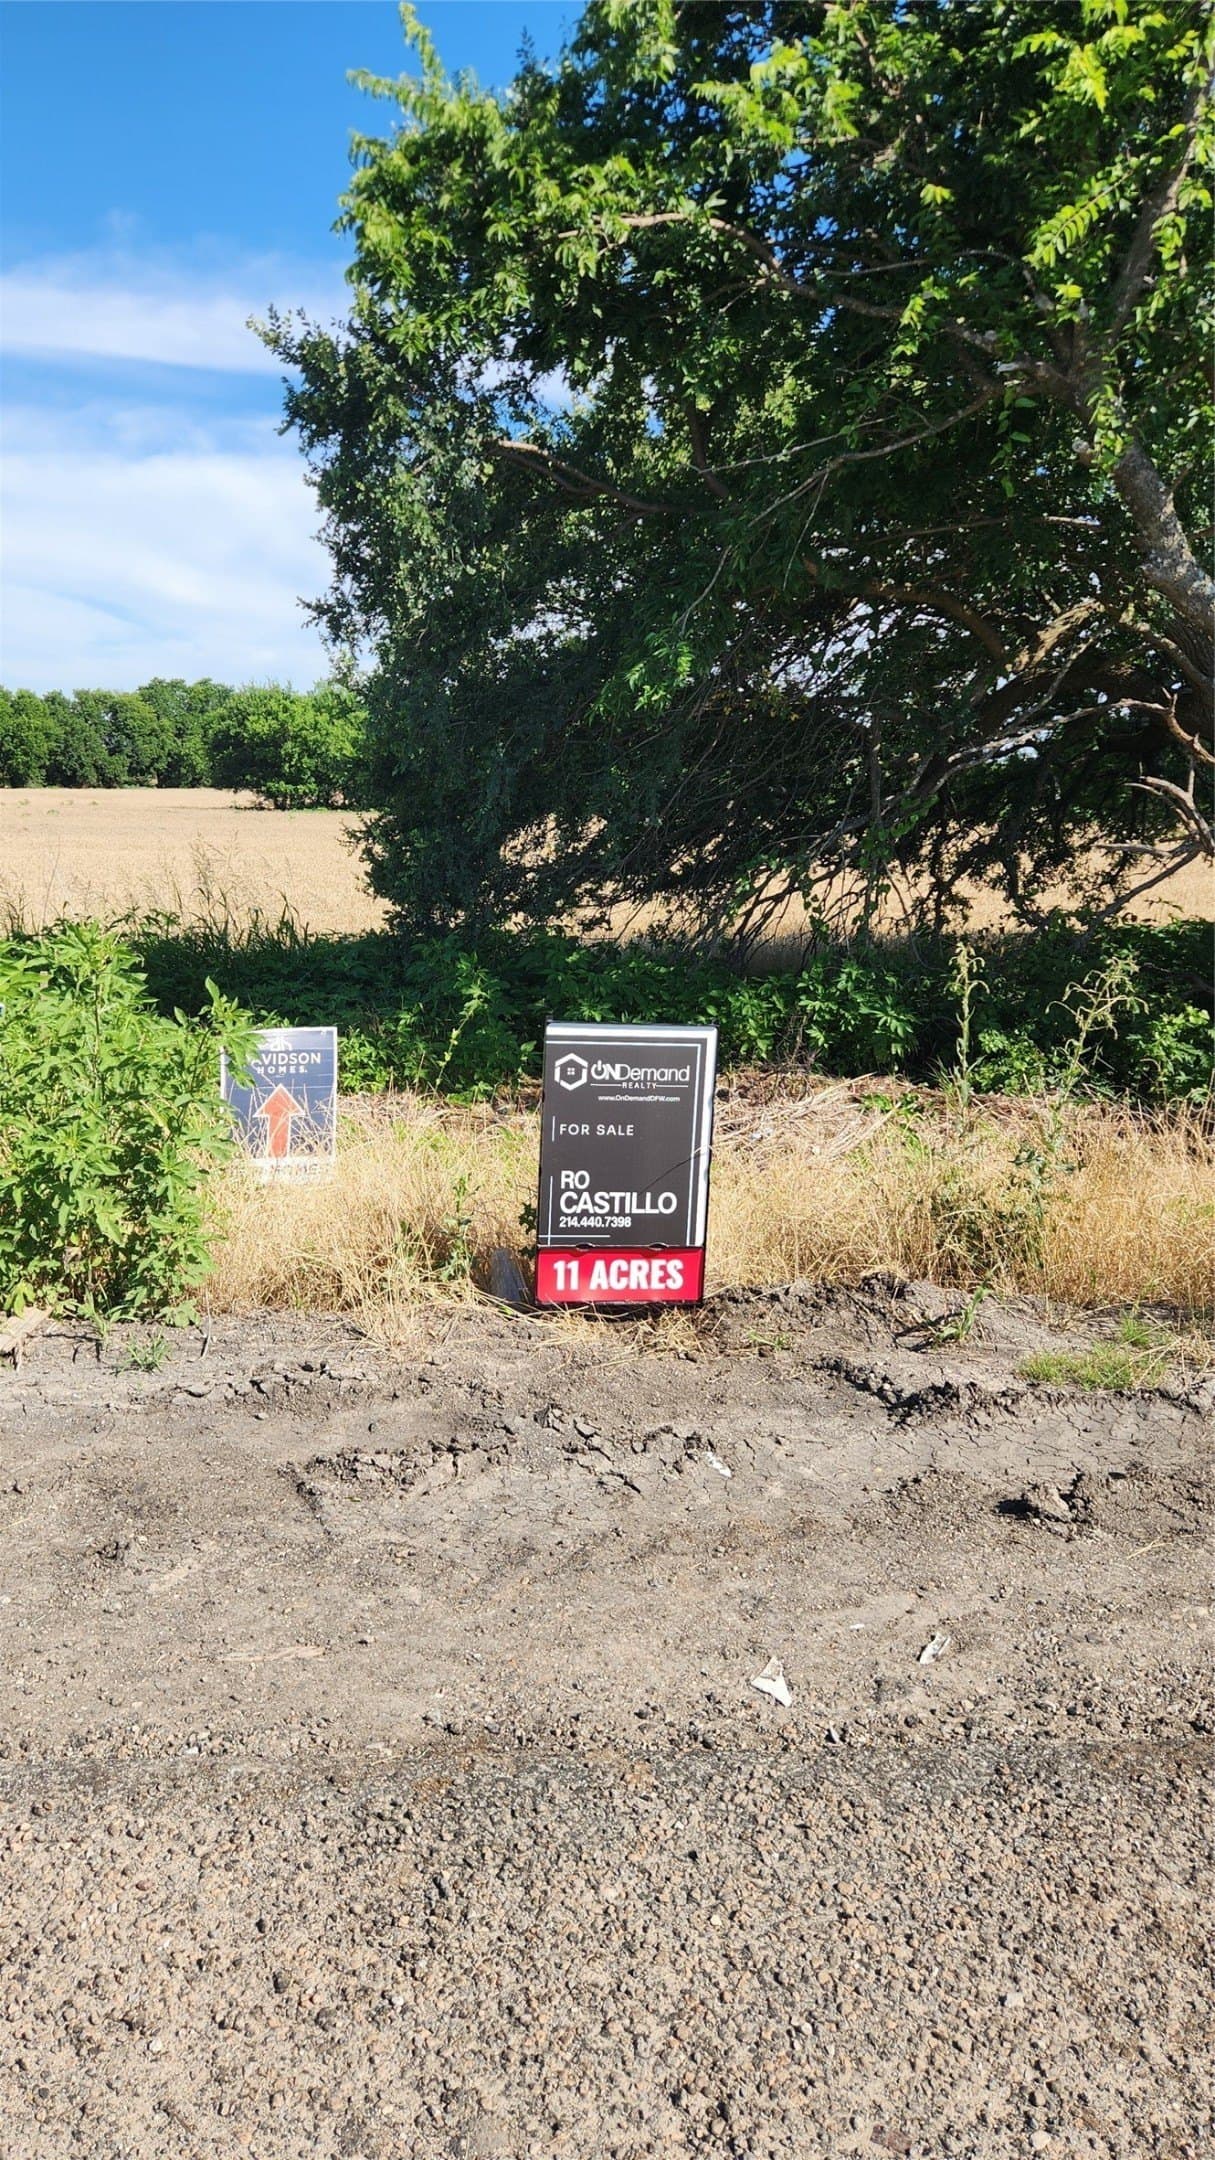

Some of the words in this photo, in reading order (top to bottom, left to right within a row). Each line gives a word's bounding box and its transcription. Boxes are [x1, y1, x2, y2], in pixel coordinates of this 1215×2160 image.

[591, 1060, 690, 1081] ONDemand
[559, 1123, 590, 1135] FOR
[596, 1124, 635, 1136] SALE
[560, 1170, 590, 1189] RO
[559, 1191, 678, 1214] CASTILLO
[559, 1216, 632, 1228] 214.440.7398
[553, 1260, 579, 1291] 11
[588, 1259, 684, 1290] ACRES
